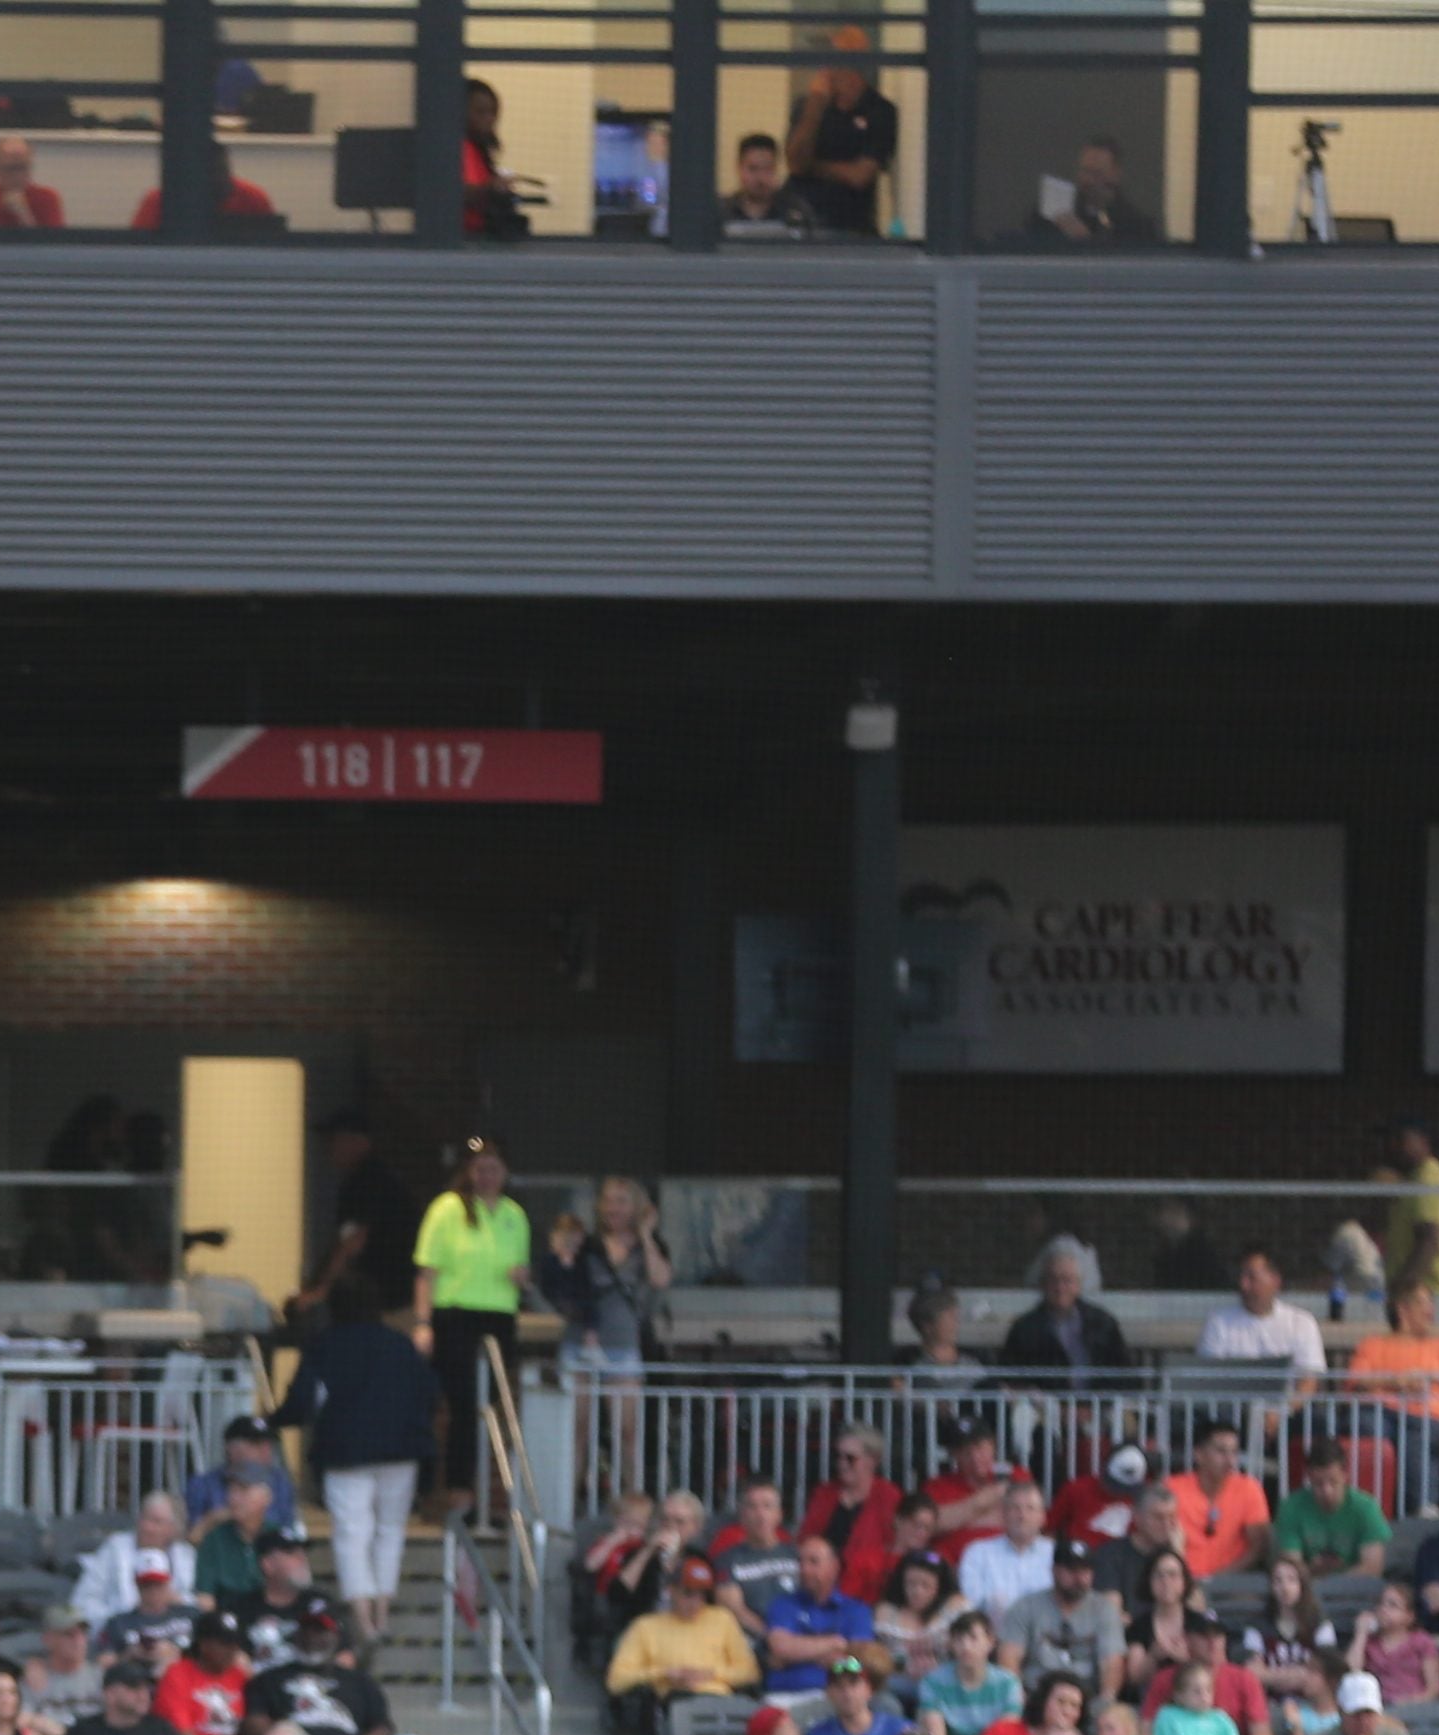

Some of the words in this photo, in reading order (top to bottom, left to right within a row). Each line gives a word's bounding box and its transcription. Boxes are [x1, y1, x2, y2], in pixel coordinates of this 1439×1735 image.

[299, 741, 371, 788] 118
[412, 741, 484, 789] 117
[1161, 901, 1277, 940] FEAR
[987, 943, 1312, 984] CARDIOLOGY
